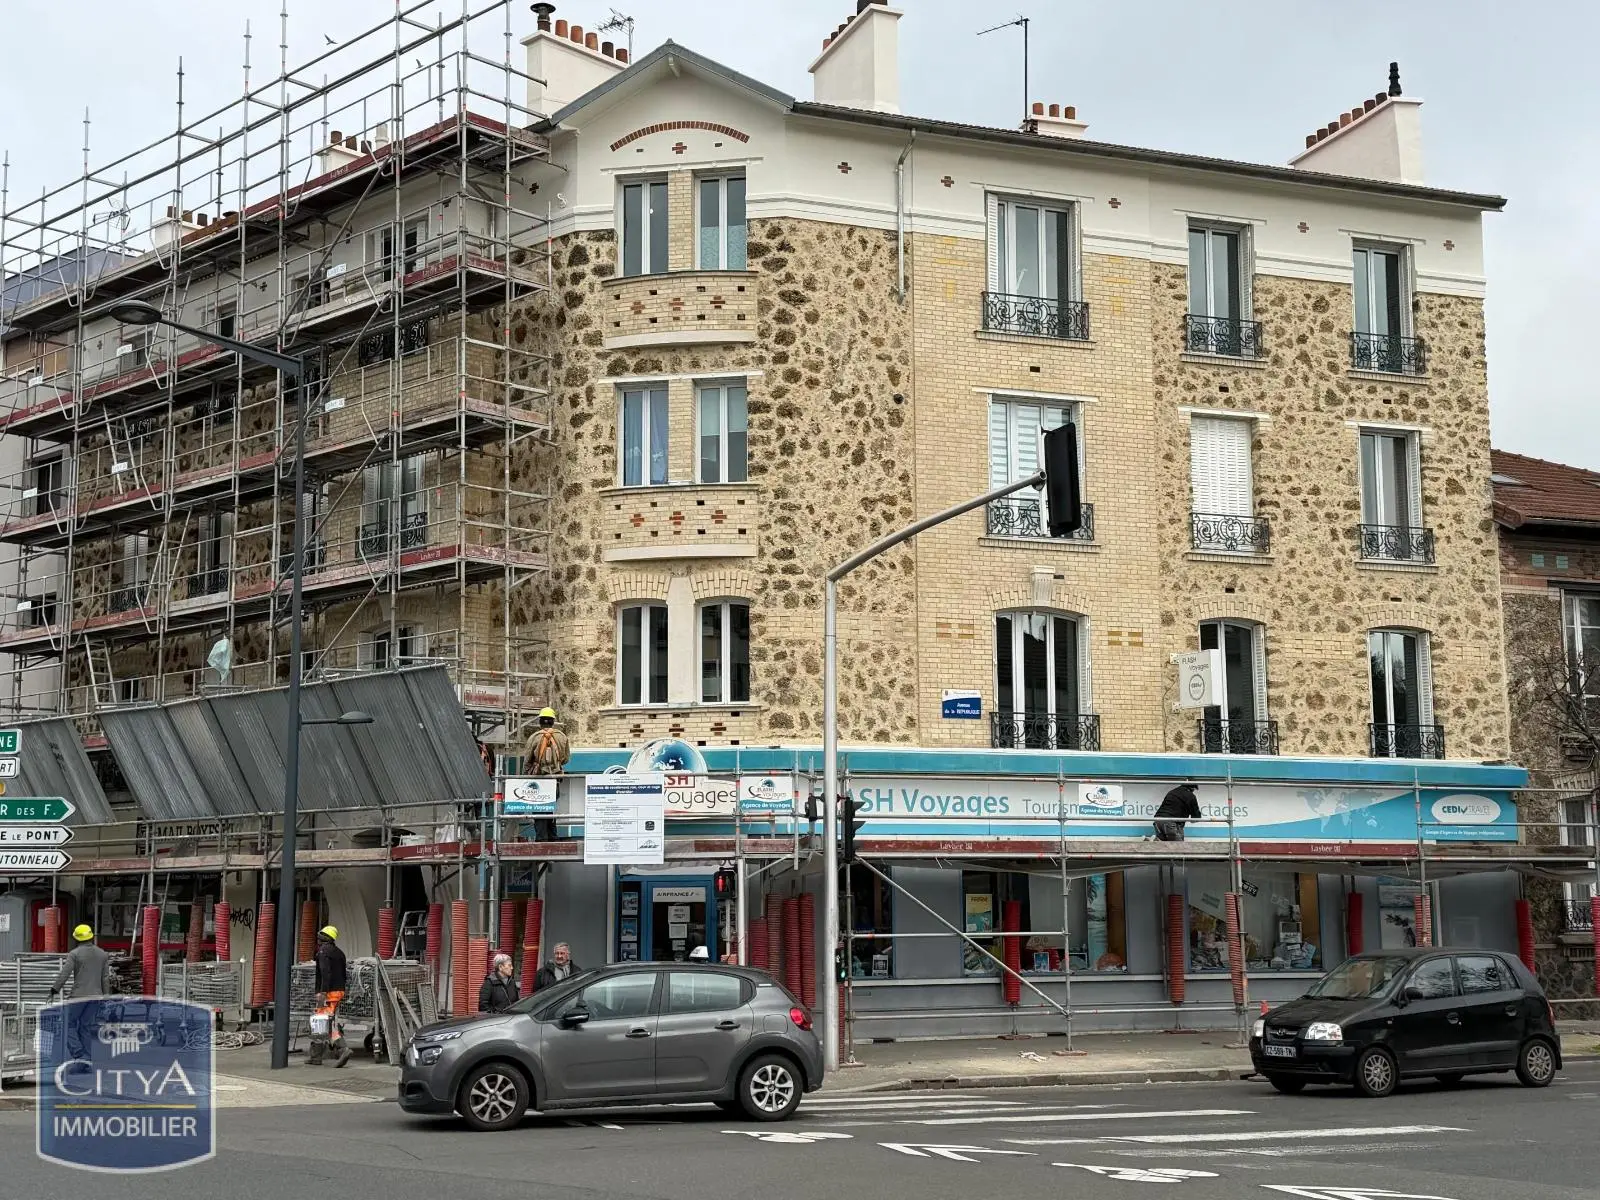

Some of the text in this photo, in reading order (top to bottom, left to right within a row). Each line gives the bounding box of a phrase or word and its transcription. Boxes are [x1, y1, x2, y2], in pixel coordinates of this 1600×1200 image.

[664, 788, 736, 809] oyages
[901, 788, 1010, 816] Voyages
[1023, 799, 1080, 814] Tourism
[17, 808, 35, 816] DES
[44, 804, 56, 816] F.
[27, 831, 59, 841] PONT
